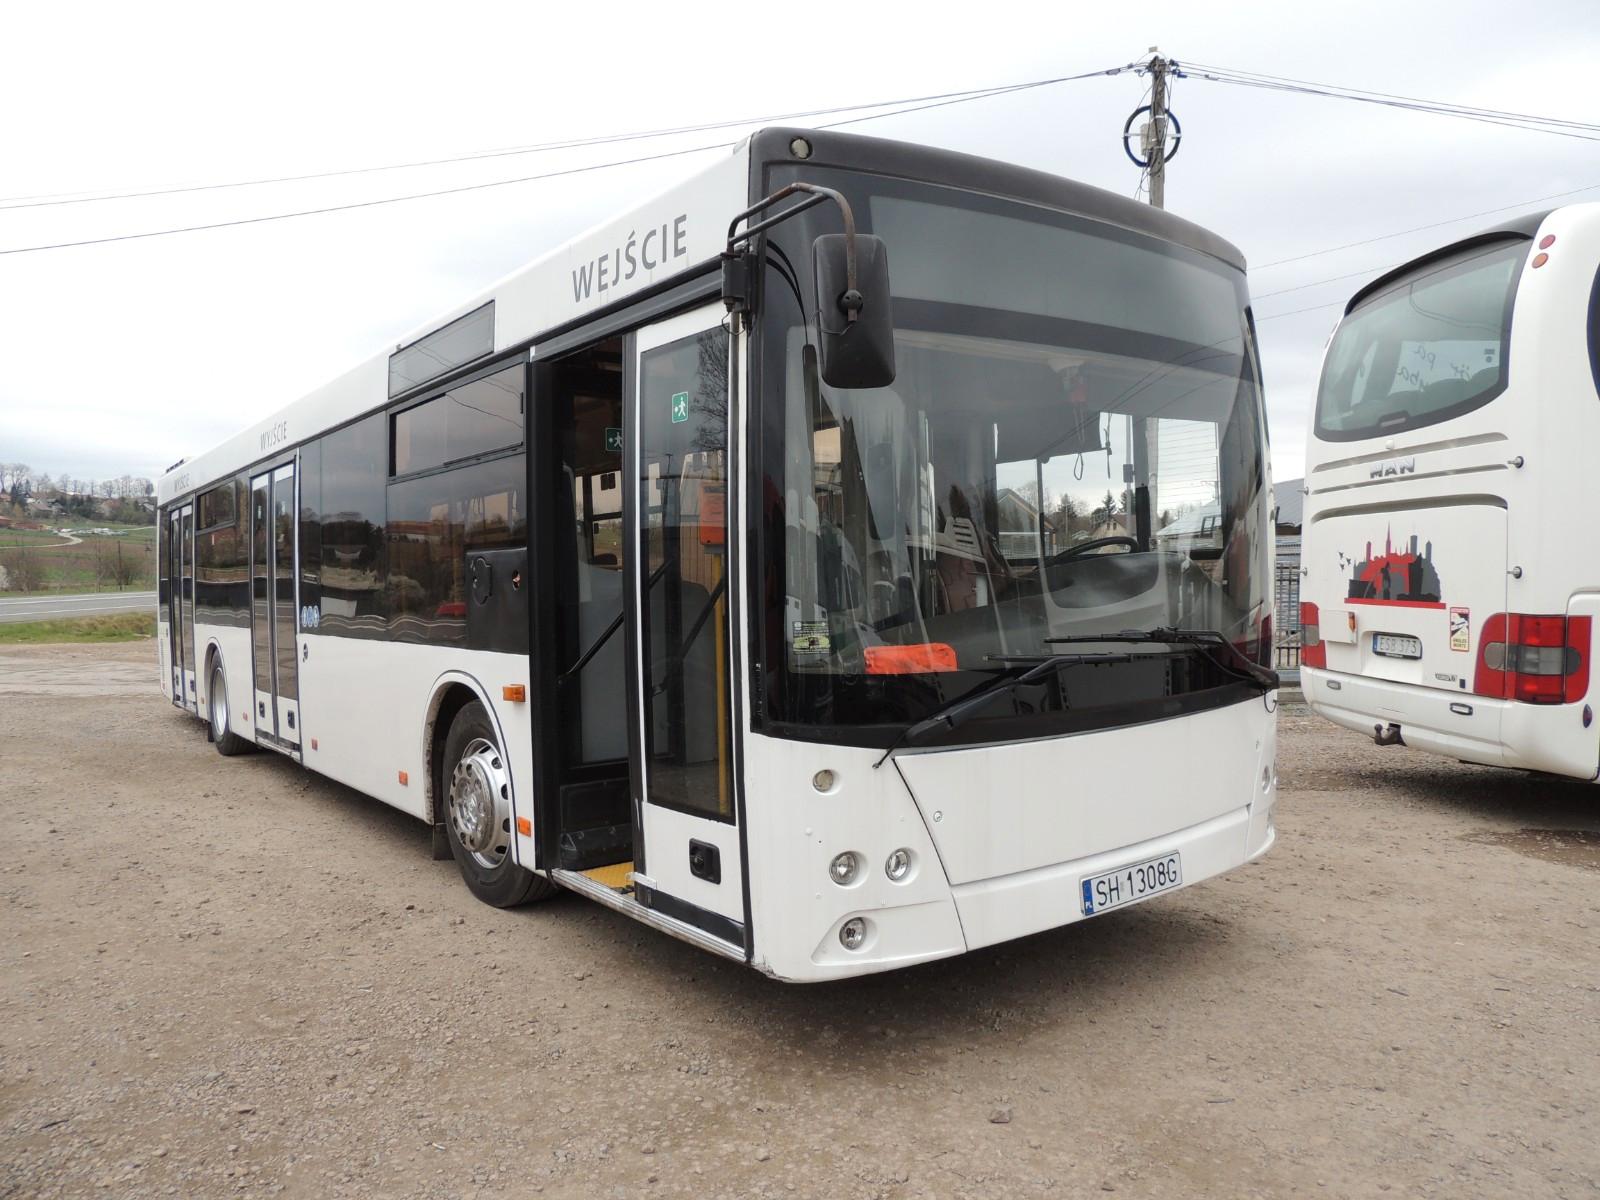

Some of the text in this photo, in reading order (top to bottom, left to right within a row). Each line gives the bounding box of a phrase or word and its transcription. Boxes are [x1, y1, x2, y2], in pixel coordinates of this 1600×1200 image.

[572, 213, 688, 303] WEJŚCIE
[260, 420, 287, 452] WYJŚCIE
[1370, 456, 1415, 479] MAN
[1096, 858, 1177, 907] SH 1308G
